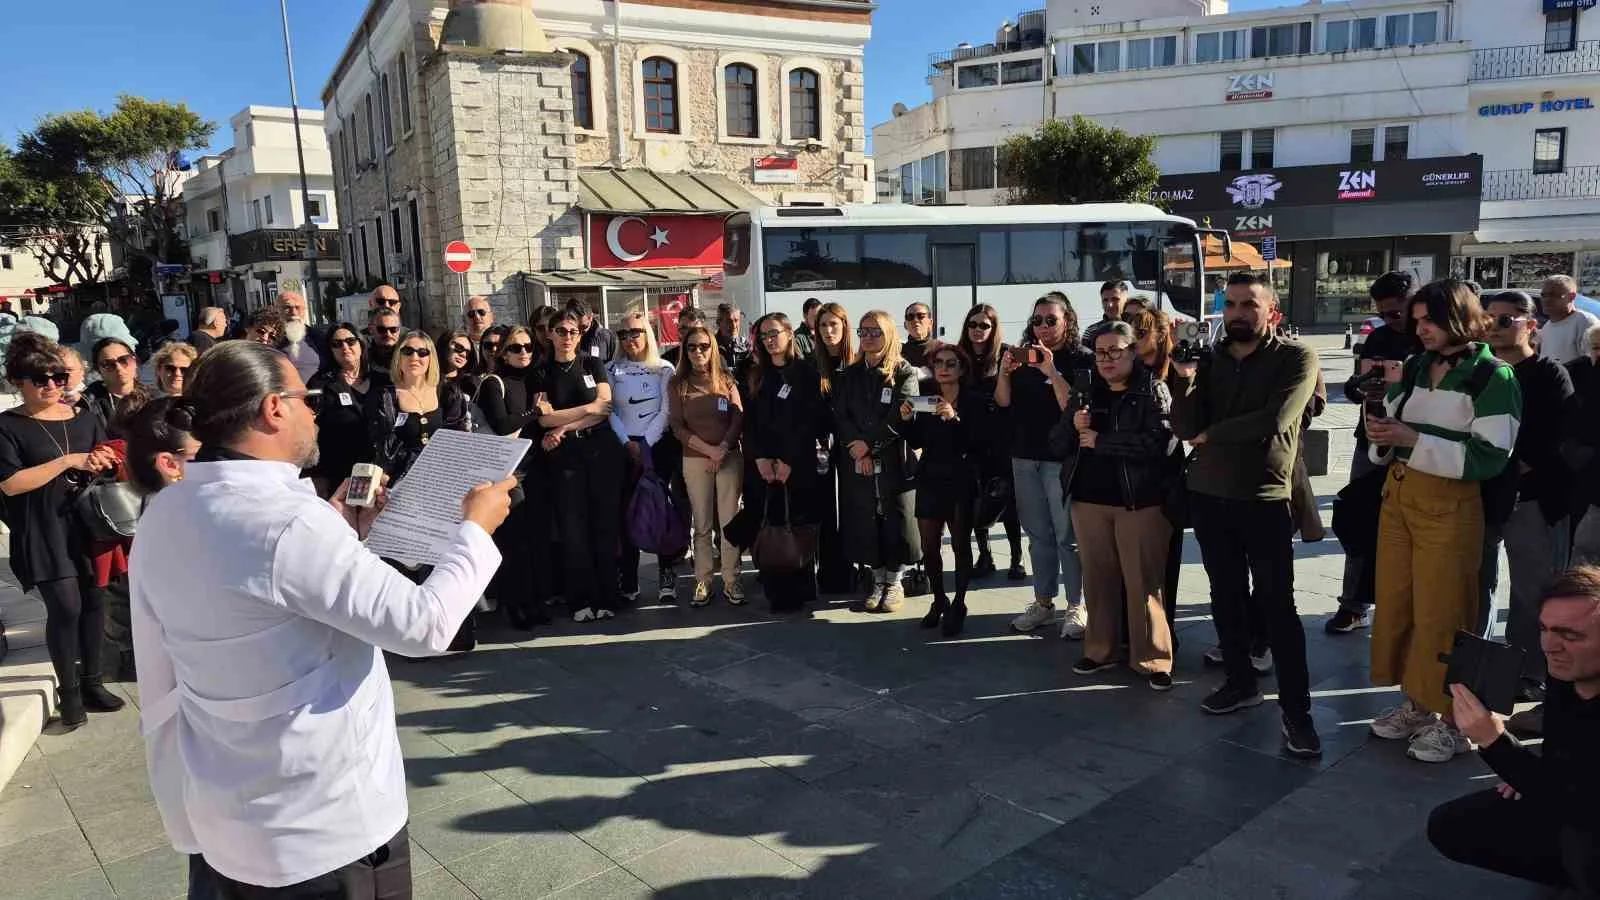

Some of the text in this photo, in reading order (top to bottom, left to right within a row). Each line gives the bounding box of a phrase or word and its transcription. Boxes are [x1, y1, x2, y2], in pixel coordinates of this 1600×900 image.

[1229, 73, 1272, 91] ZEN
[1541, 97, 1594, 112] HOTEL
[1338, 169, 1376, 190] ZEN
[1422, 172, 1470, 182] GÜNERLER
[1160, 189, 1194, 201] OLMAZ
[1235, 214, 1272, 230] ZEN
[273, 238, 328, 252] ERSN
